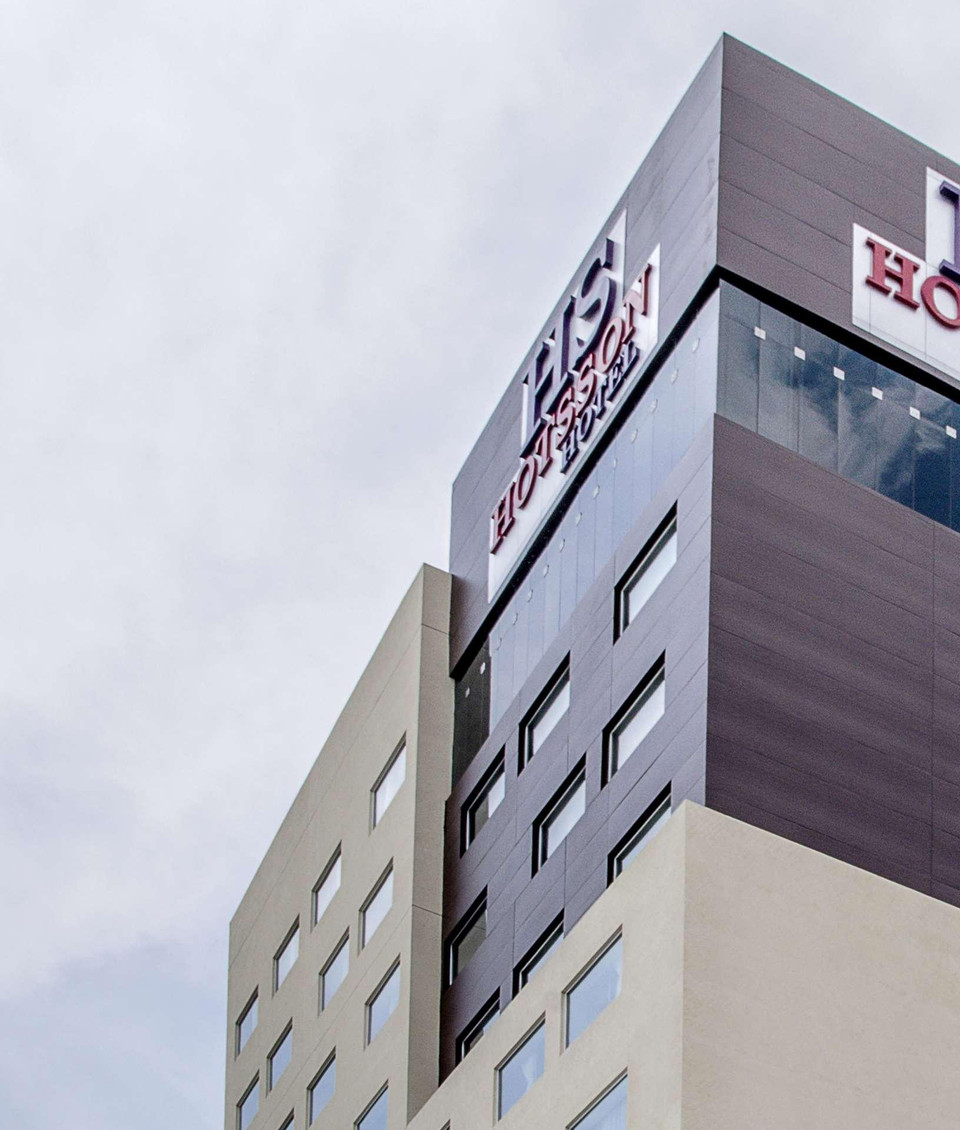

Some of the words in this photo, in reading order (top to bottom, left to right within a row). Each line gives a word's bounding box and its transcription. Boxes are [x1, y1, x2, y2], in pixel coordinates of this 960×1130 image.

[490, 263, 653, 555] HOTSSON
[520, 237, 618, 460] HS
[560, 340, 639, 475] HOTEL
